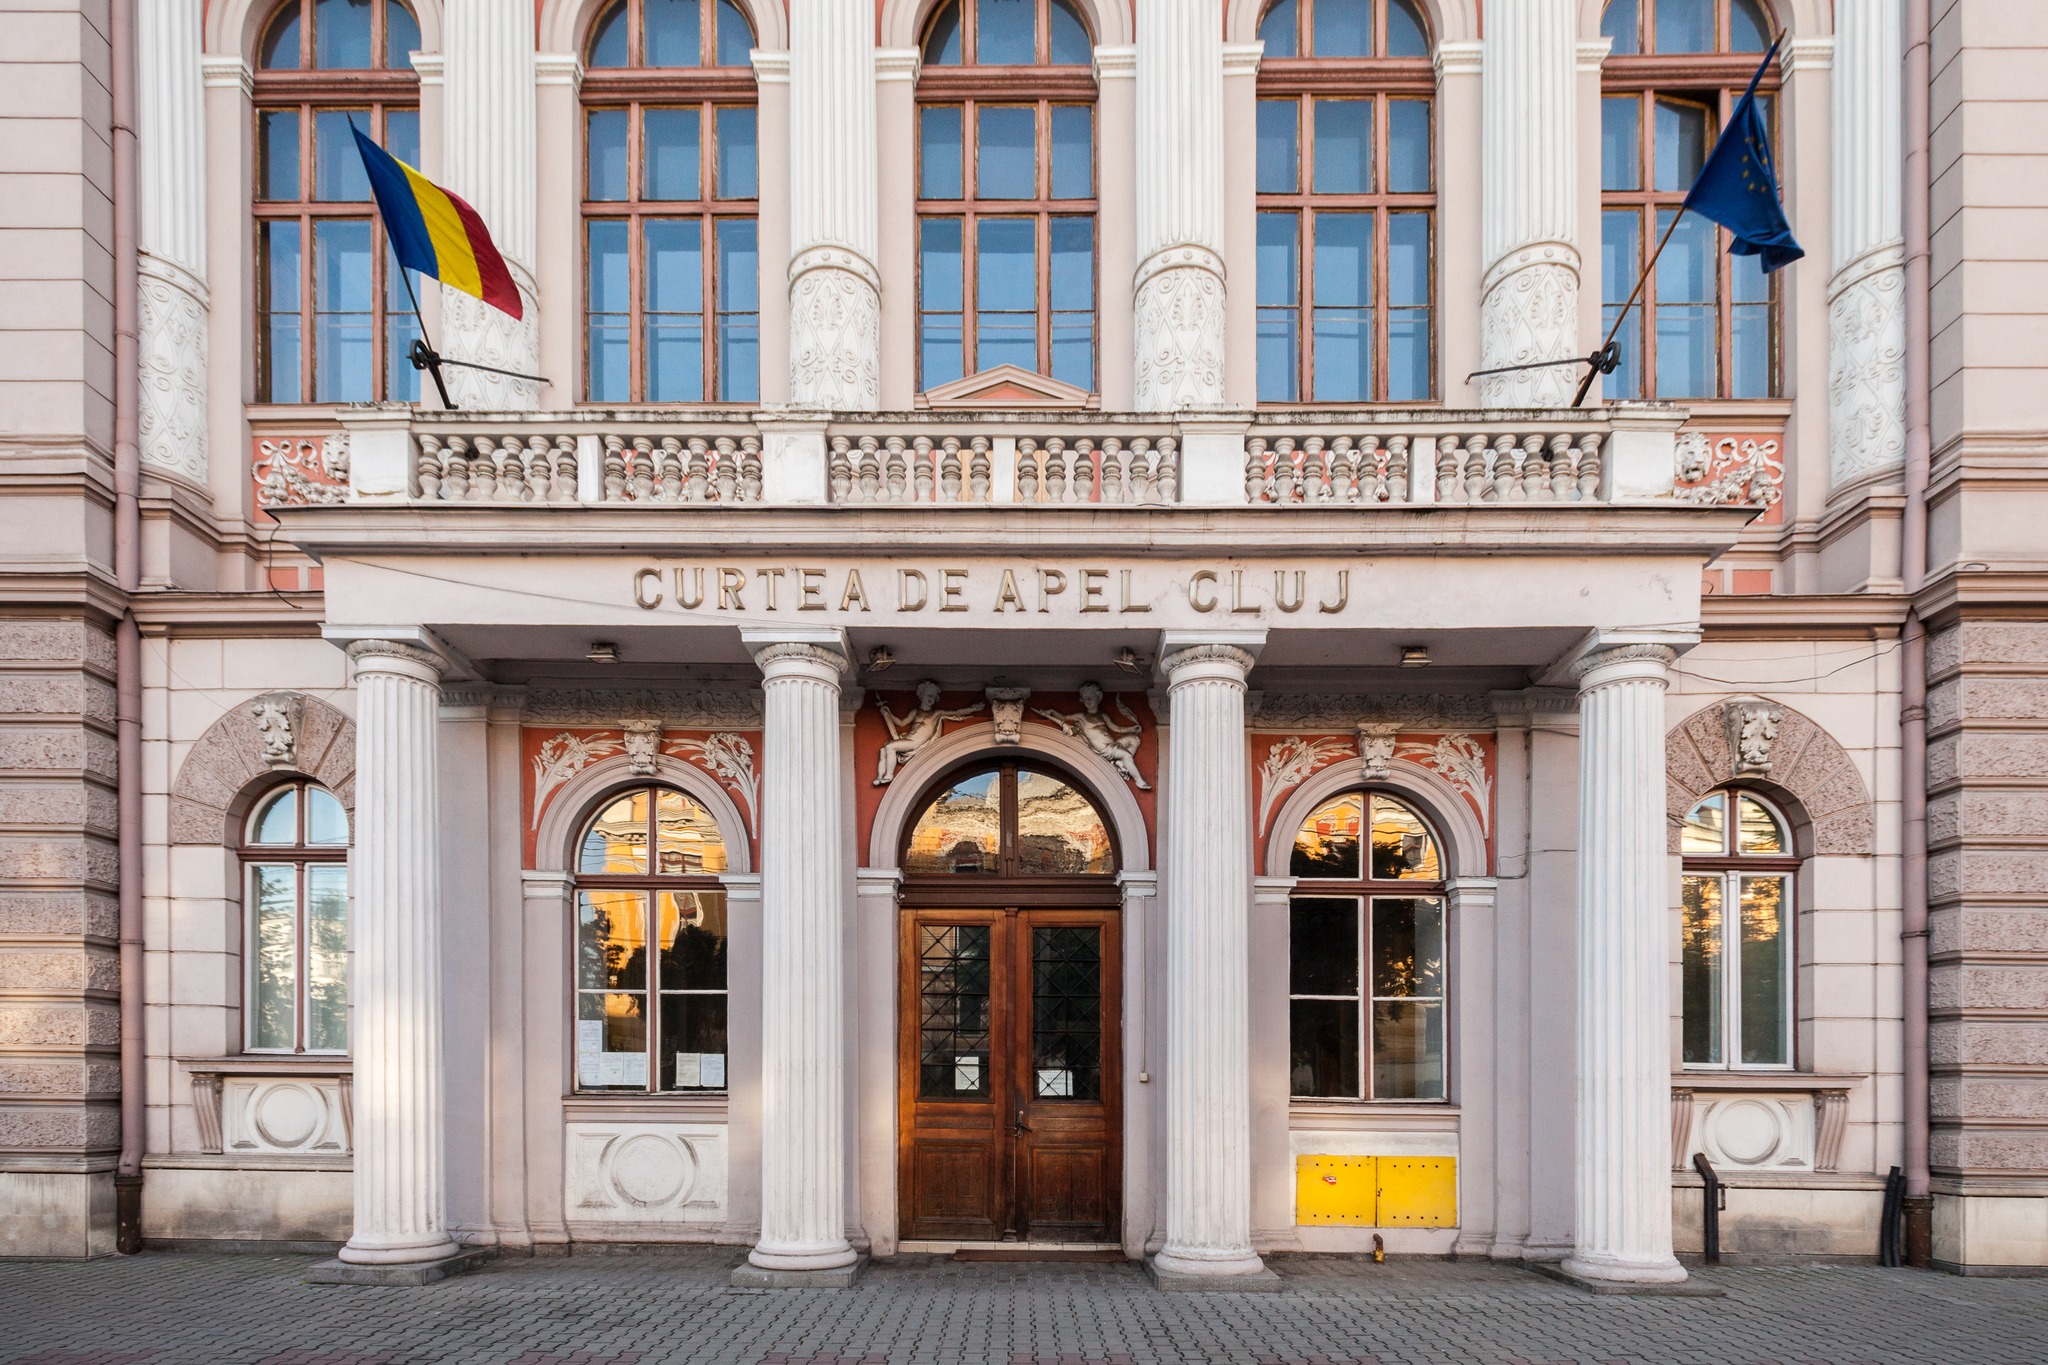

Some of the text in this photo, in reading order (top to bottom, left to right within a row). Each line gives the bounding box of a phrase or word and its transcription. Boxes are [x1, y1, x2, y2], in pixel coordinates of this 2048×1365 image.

[635, 568, 1350, 613] CURTEA DE APEL CLUJ
